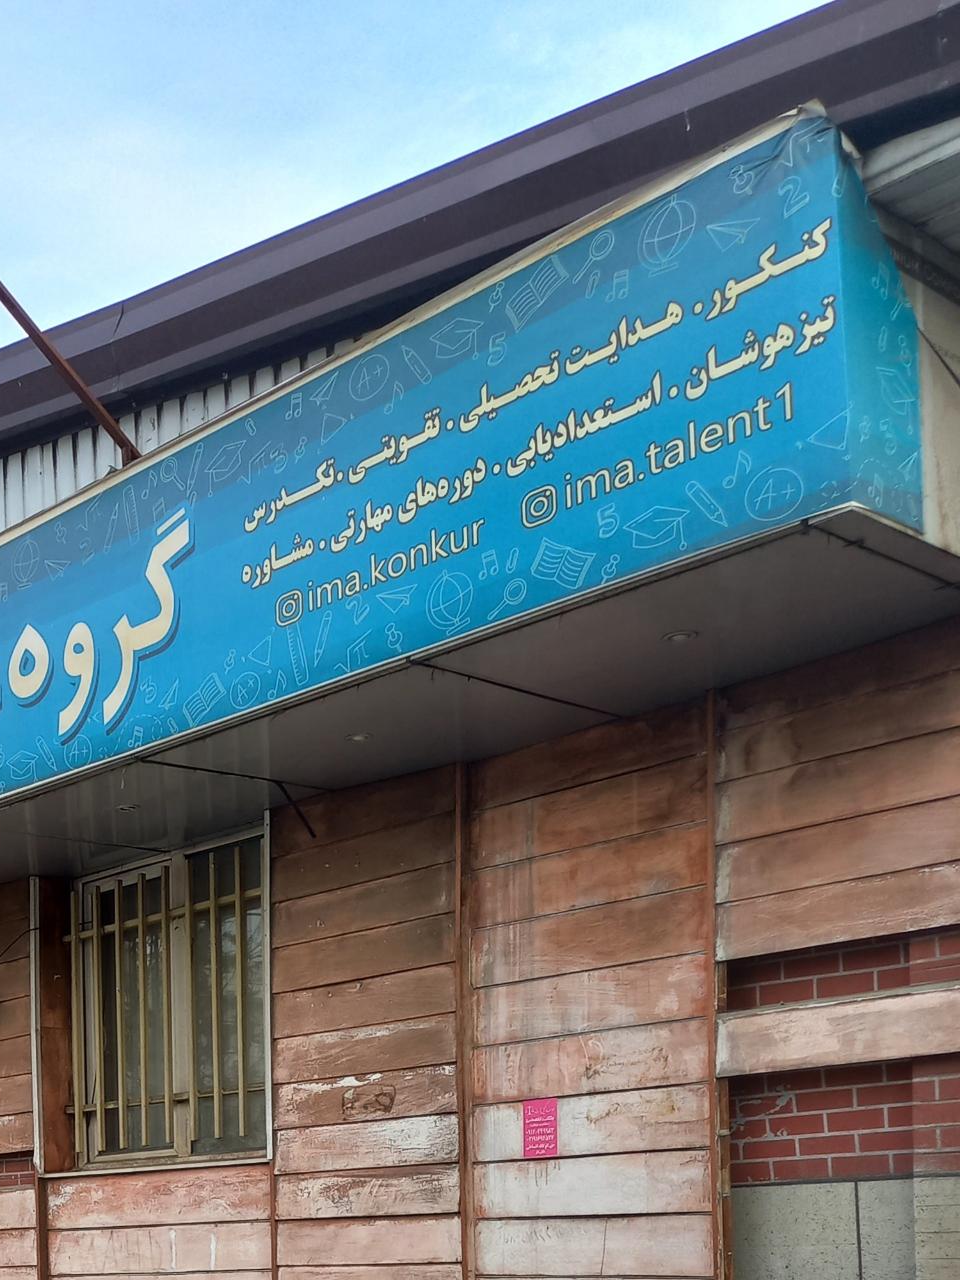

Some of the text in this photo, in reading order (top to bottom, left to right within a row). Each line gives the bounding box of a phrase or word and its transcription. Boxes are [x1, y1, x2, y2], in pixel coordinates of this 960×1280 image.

[705, 217, 833, 321] کنکور
[565, 301, 684, 375] هدایت
[459, 350, 560, 433] تحصیلی
[506, 370, 662, 477] استعدادیابی
[347, 407, 441, 484] تقویتی
[241, 534, 315, 589] مشاوره
[307, 517, 486, 612] ima.konkur
[330, 501, 393, 552] مهارتی
[6, 507, 193, 737] گروه
